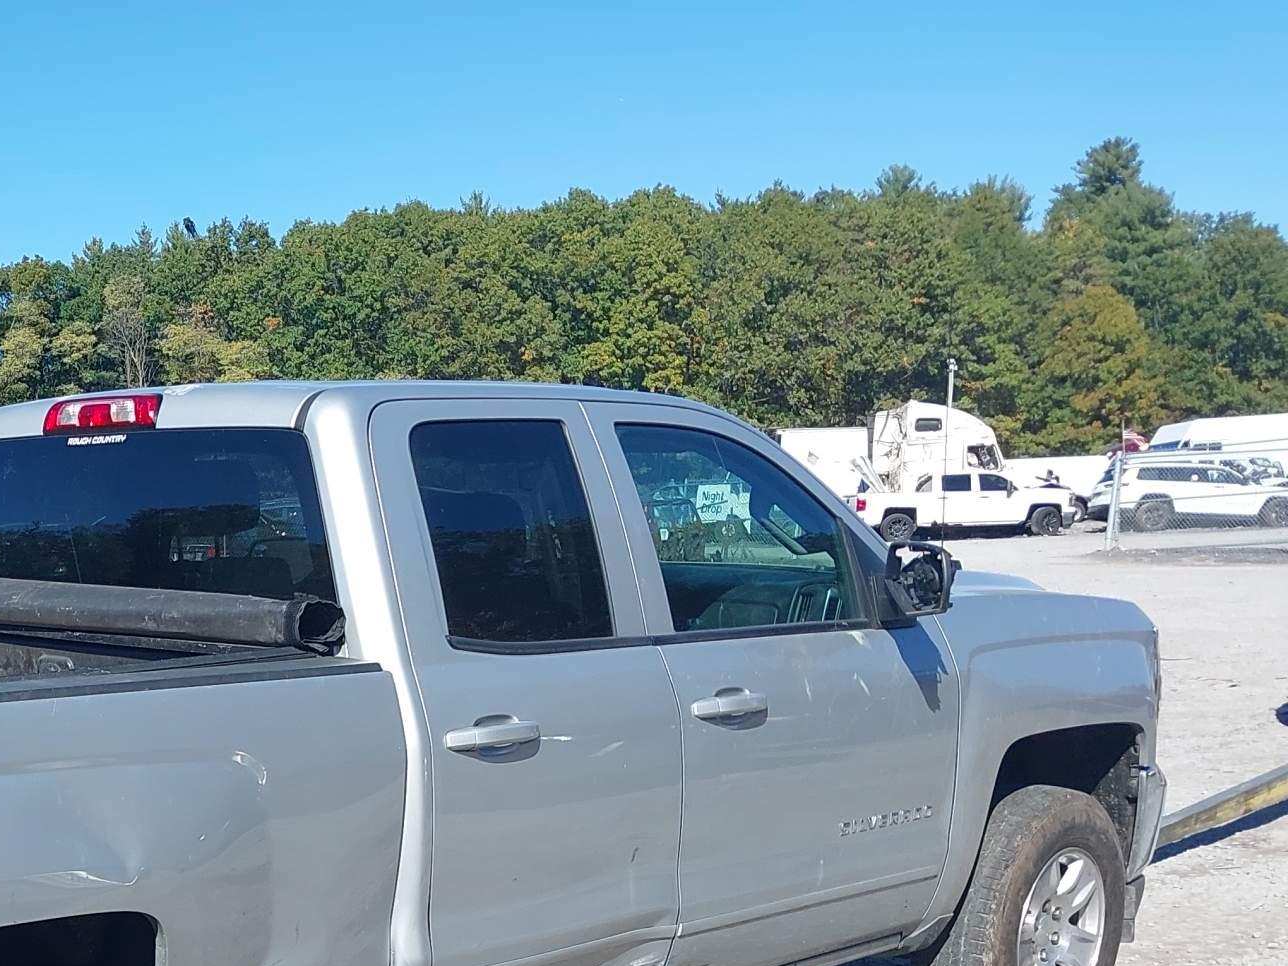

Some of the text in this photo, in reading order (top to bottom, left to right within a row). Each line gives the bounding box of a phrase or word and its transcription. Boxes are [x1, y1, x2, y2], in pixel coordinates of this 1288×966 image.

[67, 434, 127, 446] ROUGH COUNTRY
[702, 491, 724, 504] Night
[700, 503, 722, 516] Drop
[839, 804, 933, 837] SILVERADO
